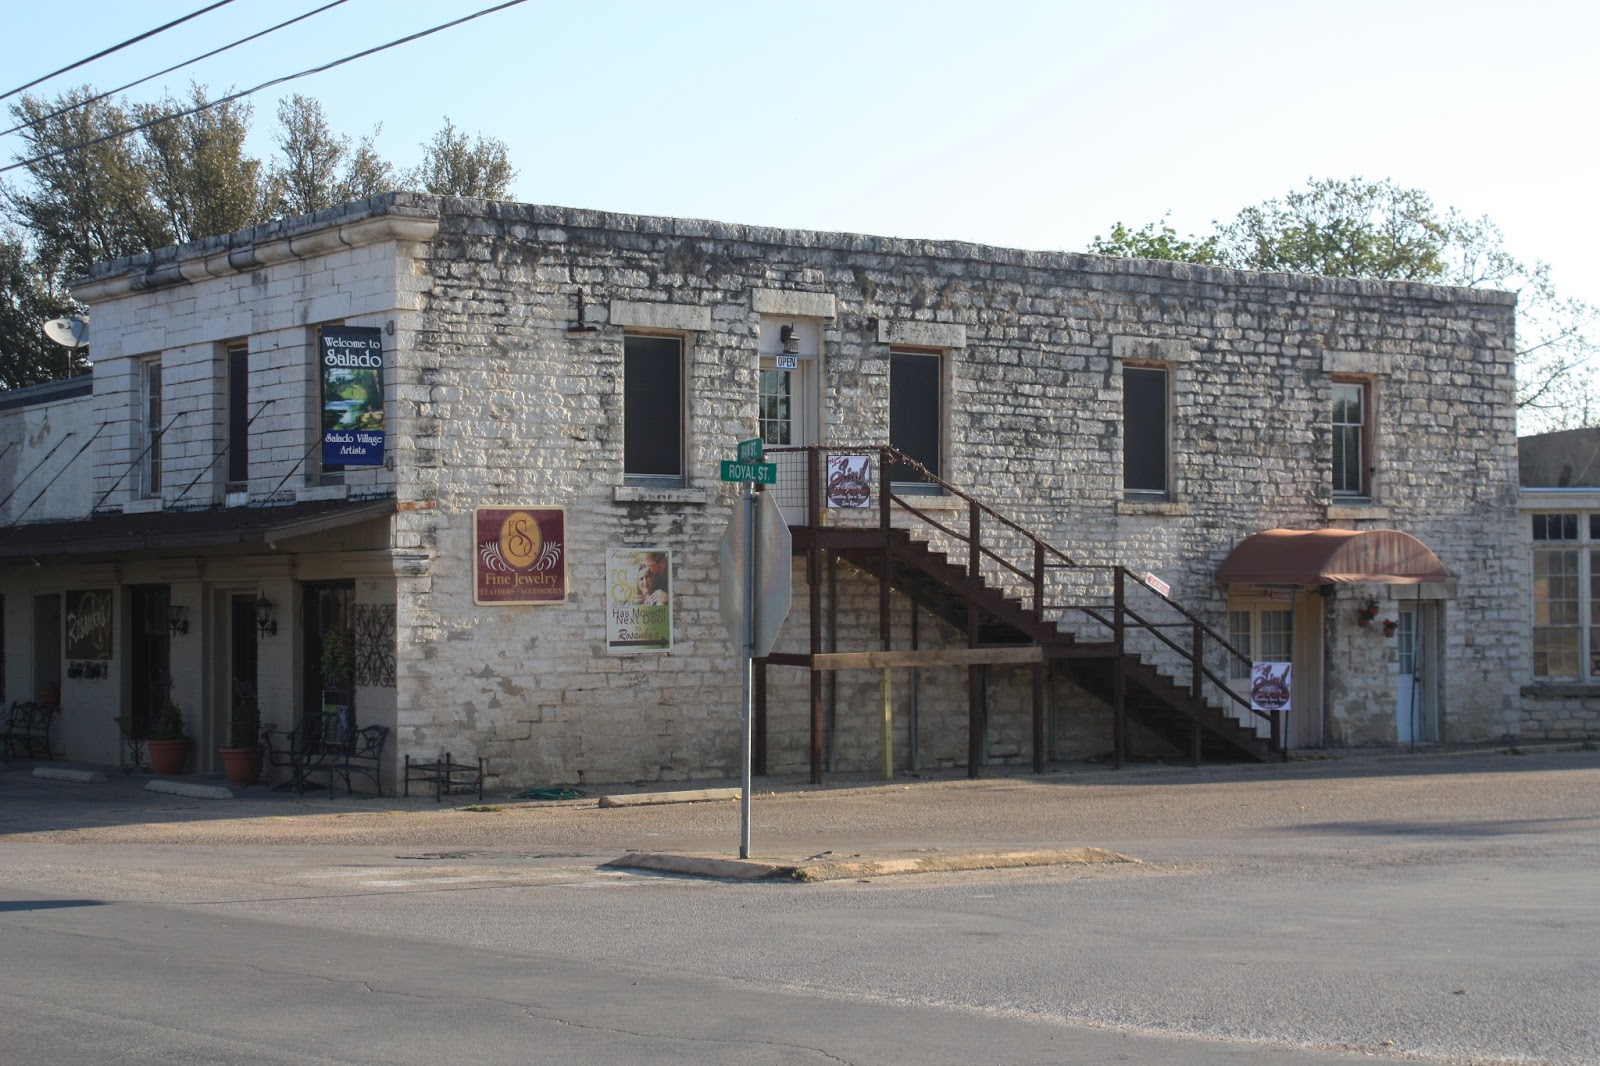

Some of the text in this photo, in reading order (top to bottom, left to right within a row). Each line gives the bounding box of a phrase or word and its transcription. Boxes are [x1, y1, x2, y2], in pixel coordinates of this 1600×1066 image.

[324, 337, 380, 349] Welcome to
[325, 349, 382, 368] Salado
[777, 357, 796, 368] OPEN
[325, 433, 382, 446] Salado Village
[340, 445, 366, 455] Artists
[729, 464, 770, 481] ROYAL ST.
[485, 571, 558, 587] Fine Jewelry
[521, 587, 562, 595] ACCESSORIES
[612, 609, 629, 618] Has
[616, 614, 667, 625] Next Door
